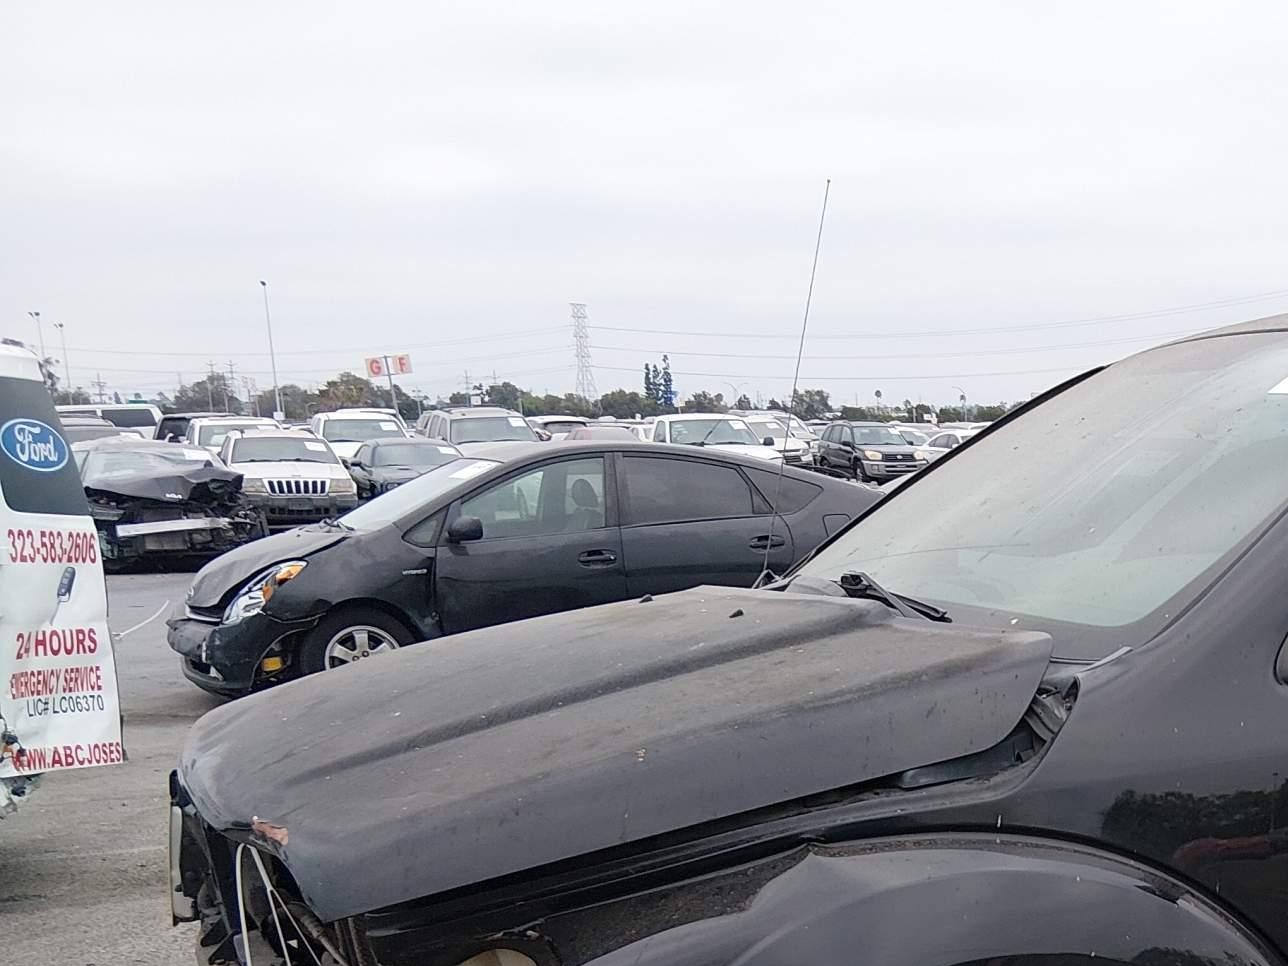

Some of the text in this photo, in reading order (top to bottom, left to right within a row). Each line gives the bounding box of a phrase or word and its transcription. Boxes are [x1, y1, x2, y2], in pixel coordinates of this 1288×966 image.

[14, 424, 58, 462] Ford
[7, 528, 97, 564] 323-583-2606
[16, 628, 98, 660] 24 HOURS
[10, 665, 103, 700] EMERGENCY SERVICE
[26, 694, 105, 718] LIC# LC06370
